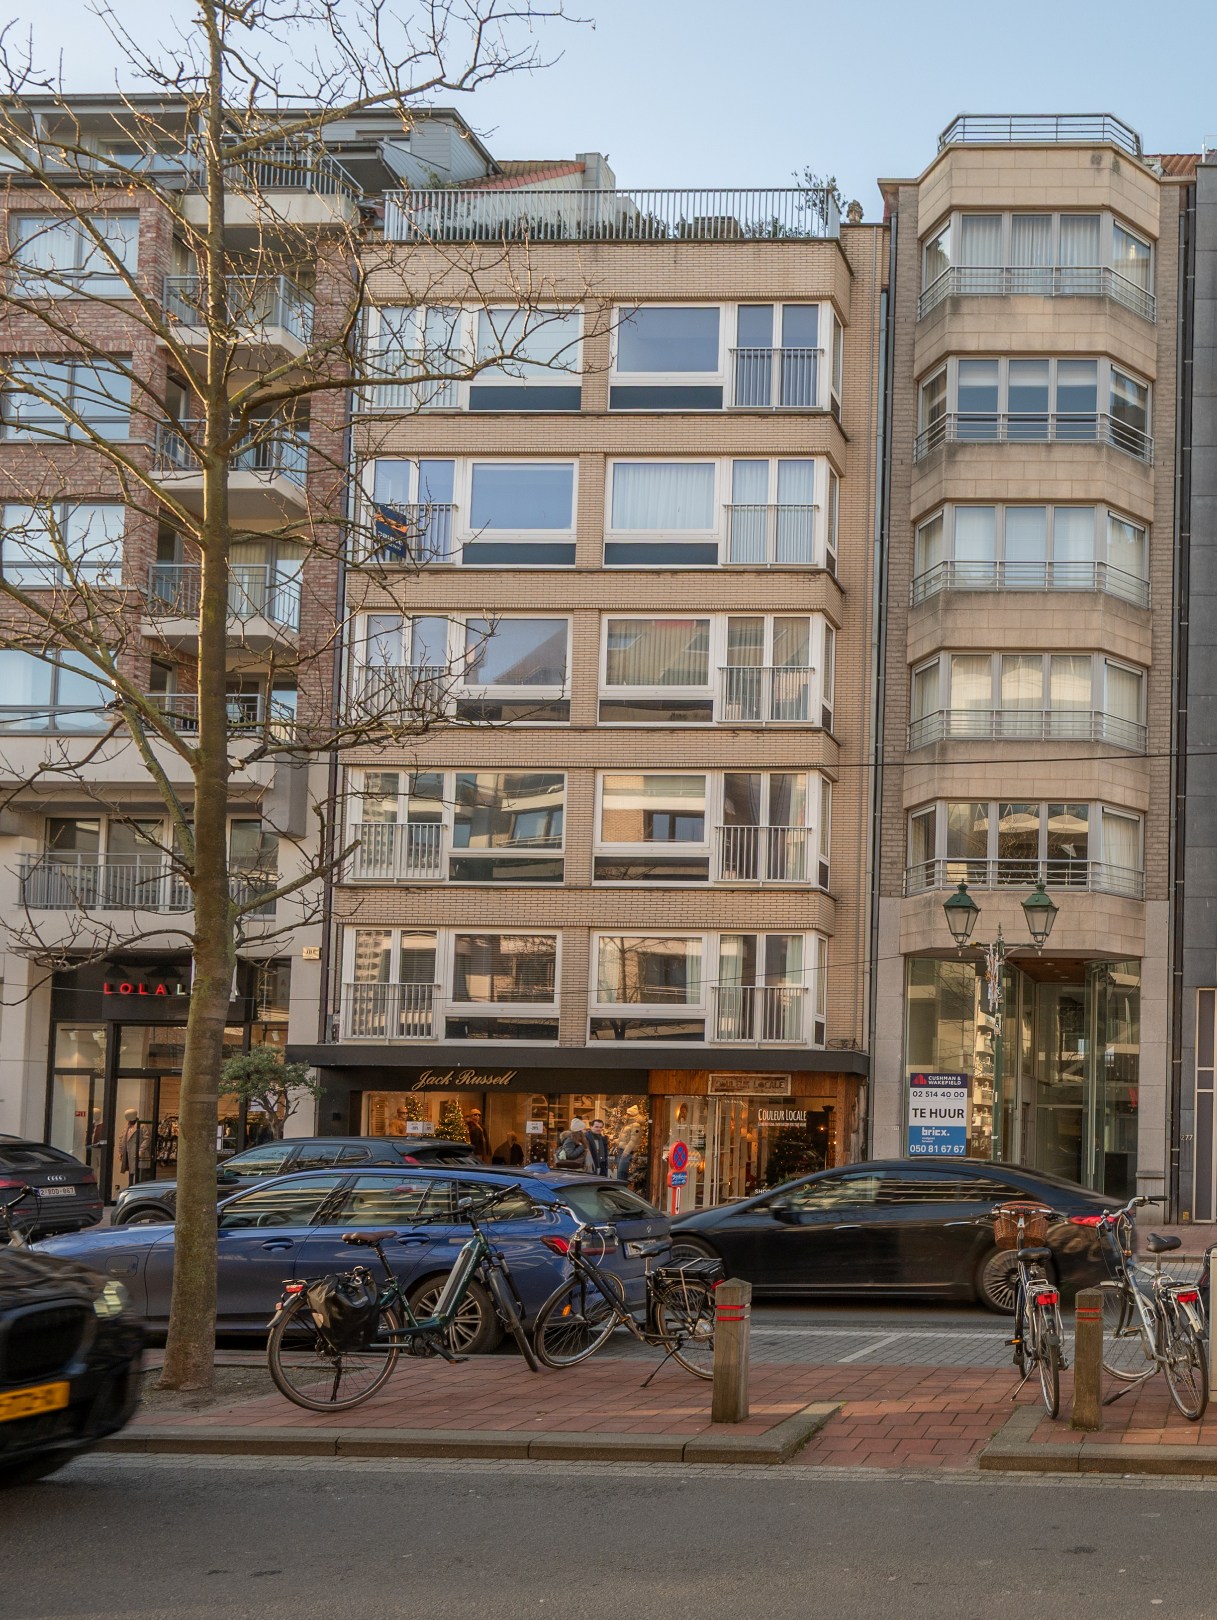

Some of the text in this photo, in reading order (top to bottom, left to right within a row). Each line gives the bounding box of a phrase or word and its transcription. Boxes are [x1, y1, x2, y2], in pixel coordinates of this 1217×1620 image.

[411, 1069, 517, 1091] Jack Russell
[912, 1090, 923, 1098] 02
[757, 1108, 807, 1121] COULEUR LOCALE
[912, 1108, 965, 1119] TE HUUR
[909, 1144, 965, 1153] 050 81 67 67
